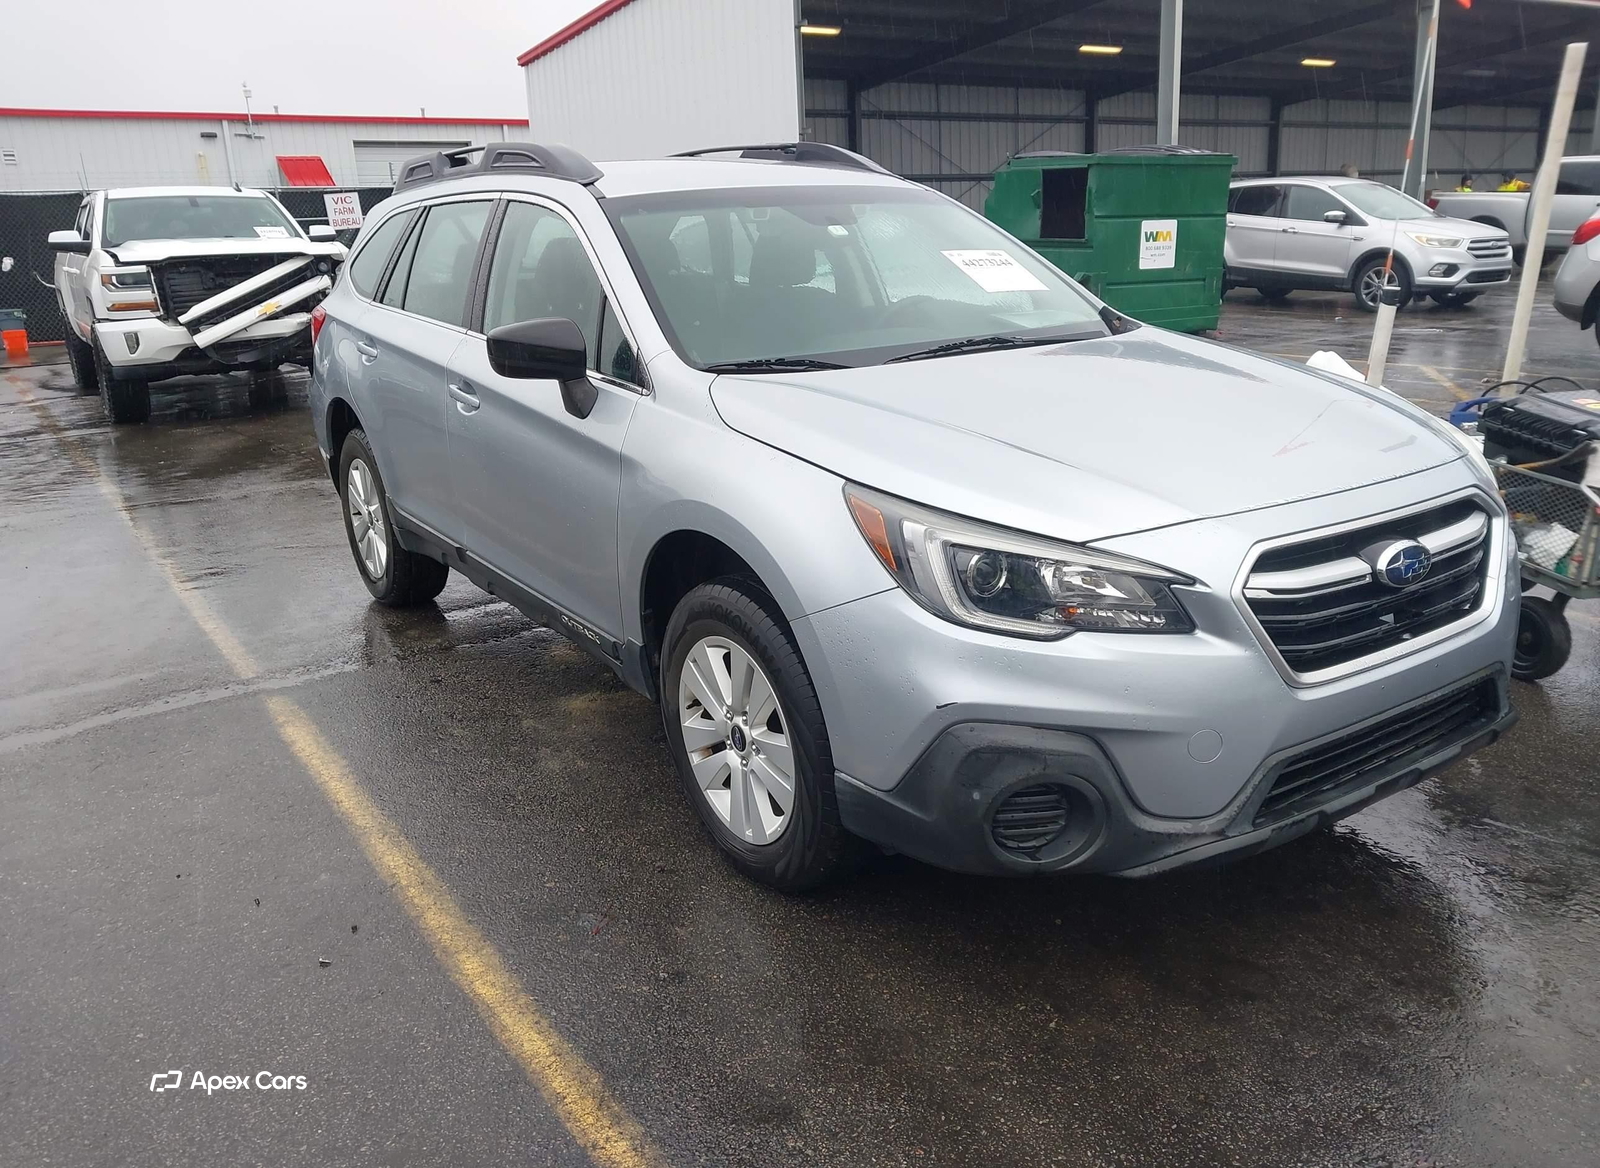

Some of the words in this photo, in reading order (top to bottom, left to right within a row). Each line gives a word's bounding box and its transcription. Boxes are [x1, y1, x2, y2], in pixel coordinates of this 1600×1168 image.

[331, 195, 353, 205] VIC
[333, 206, 356, 216] FARM
[332, 217, 361, 227] BUREAU
[1144, 230, 1173, 243] WM
[962, 258, 1014, 267] 44273244
